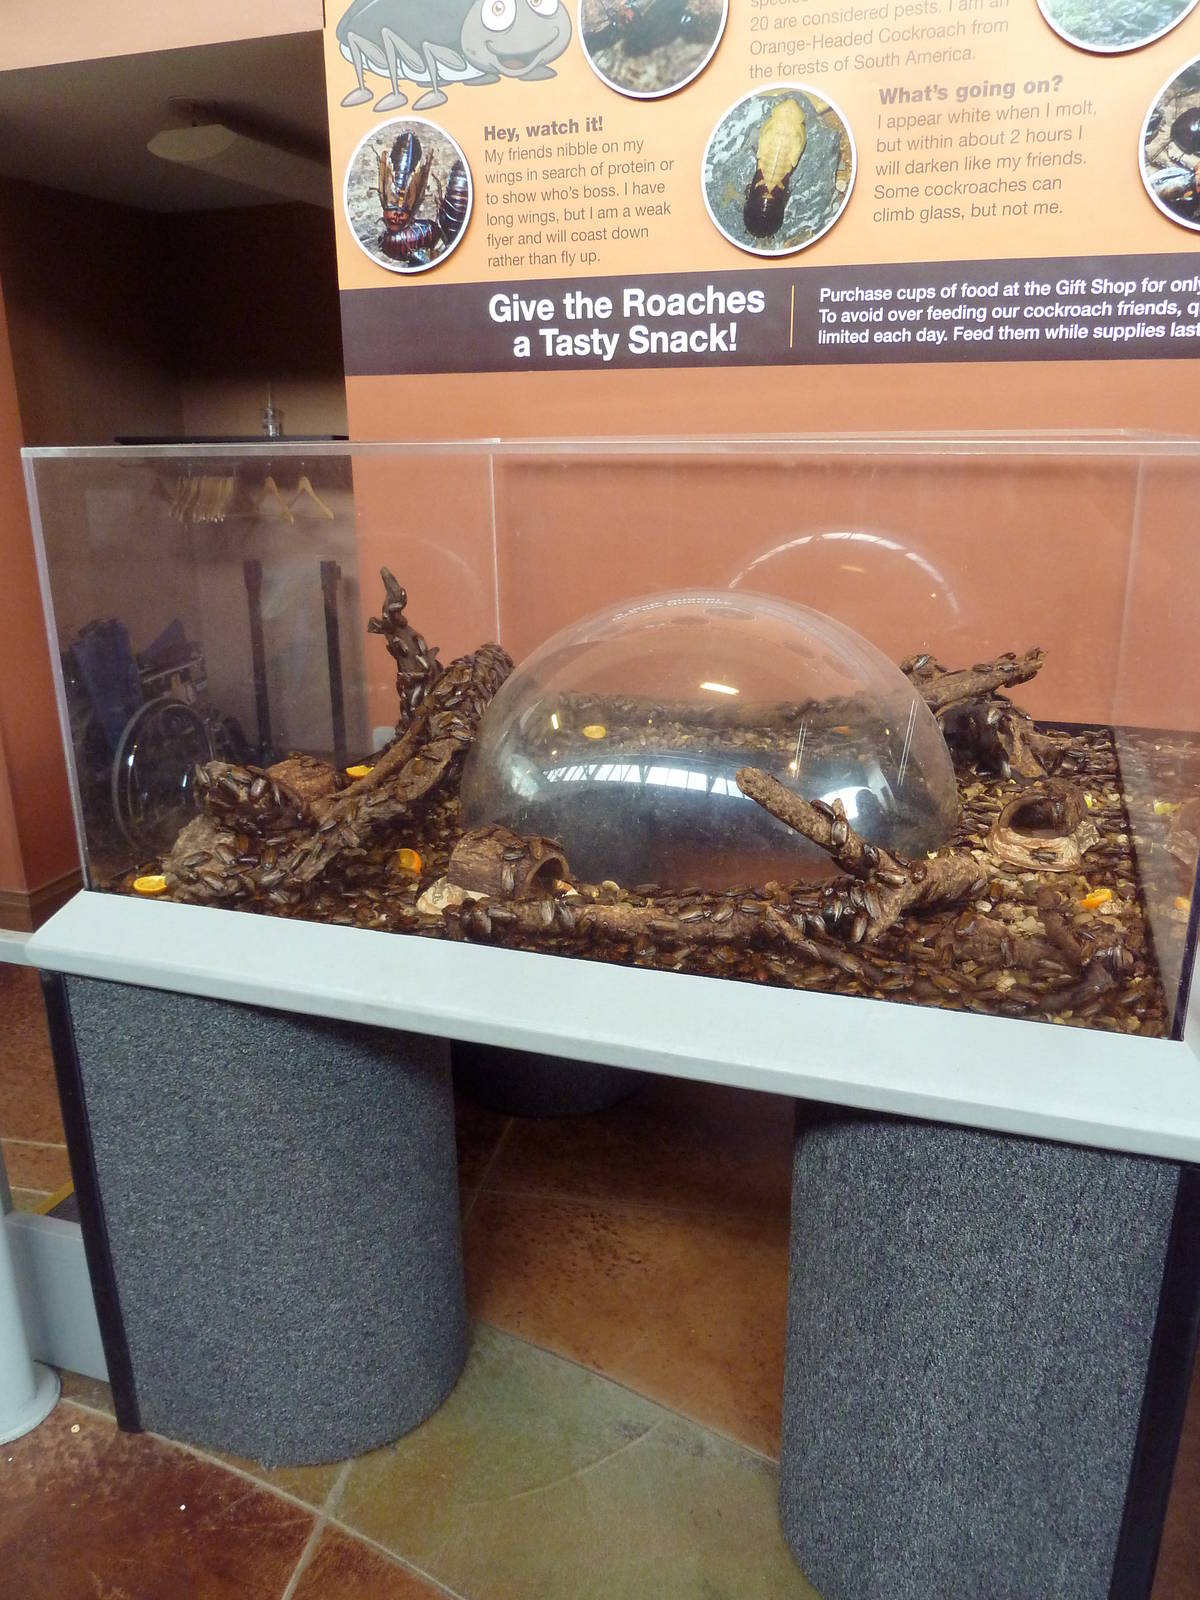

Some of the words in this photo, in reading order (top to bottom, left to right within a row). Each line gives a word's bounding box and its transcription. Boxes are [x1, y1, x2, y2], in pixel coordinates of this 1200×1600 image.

[750, 16, 768, 31] 20
[774, 16, 796, 29] are
[802, 2, 888, 26] considered
[750, 30, 872, 56] Orange-Headed
[879, 20, 965, 42] Cockroach
[971, 19, 1009, 34] from
[750, 64, 772, 79] the
[778, 60, 828, 76] forests
[834, 57, 850, 72] of
[854, 52, 900, 70] South
[906, 48, 975, 65] America.
[956, 81, 1016, 102] going
[1024, 75, 1063, 94] on?
[484, 125, 520, 142] Hey,
[526, 118, 579, 137] watch
[586, 116, 603, 132] it!
[877, 115, 881, 128] I
[887, 112, 942, 131] appear
[948, 108, 990, 124] white
[997, 105, 1040, 121] when
[1045, 103, 1049, 117] I
[877, 138, 901, 152] but
[908, 135, 953, 151] within
[959, 132, 1005, 147] about
[1010, 129, 1020, 144] 2
[1026, 127, 1072, 142] hours
[1078, 125, 1082, 140] I
[485, 149, 504, 165] My
[508, 145, 552, 161] friends
[557, 141, 597, 157] nibble
[602, 141, 618, 153] on
[624, 139, 644, 153] my
[876, 162, 899, 176] will
[905, 160, 958, 175] darken
[964, 156, 990, 171] like
[997, 157, 1020, 172] my
[1027, 151, 1086, 167] friends.
[485, 169, 522, 185] wings
[527, 169, 537, 180] in
[542, 165, 585, 179] search
[591, 163, 604, 176] of
[608, 159, 655, 178] protein
[660, 159, 674, 171] or
[486, 193, 498, 205] to
[503, 190, 536, 204] show
[584, 184, 619, 198] boss.
[623, 182, 627, 195] I
[632, 181, 665, 195] have
[874, 184, 919, 200] Some
[925, 178, 1027, 196] cockroaches
[1032, 178, 1062, 191] can
[487, 213, 513, 228] long
[518, 211, 559, 226] wings,
[564, 208, 585, 221] but
[589, 207, 593, 219] I
[598, 207, 618, 219] am
[622, 207, 631, 217] a
[636, 202, 671, 216] weak
[873, 207, 914, 223] climb
[920, 206, 964, 223] glass,
[971, 203, 996, 218] but
[1002, 202, 1028, 216] not
[1034, 202, 1063, 215] me.
[487, 233, 513, 249] flyer
[518, 232, 541, 245] and
[546, 230, 567, 243] will
[571, 228, 607, 242] coast
[612, 227, 649, 240] down
[488, 254, 525, 267] rather
[529, 252, 556, 264] than
[561, 251, 576, 266] fly
[580, 251, 600, 265] up.
[820, 288, 892, 302] Purchase
[896, 288, 936, 302] cups
[940, 284, 957, 299] of
[961, 282, 998, 298] food
[1003, 283, 1019, 297] at
[1024, 281, 1050, 296] the
[1056, 279, 1086, 295] Gift
[1091, 279, 1136, 296] Shop
[1141, 277, 1166, 292] for
[489, 294, 555, 322] Give
[563, 291, 613, 319] the
[623, 285, 765, 317] Roaches
[819, 308, 837, 323] To
[841, 307, 882, 323] avoid
[888, 308, 922, 322] over
[927, 306, 987, 322] feeding
[991, 306, 1019, 319] our
[1023, 302, 1112, 318] cockroach
[1117, 301, 1182, 318] friends,
[513, 336, 531, 357] a
[539, 328, 619, 362] Tasty
[628, 323, 737, 355] Snack!
[818, 329, 869, 344] limited
[873, 328, 911, 343] each
[916, 328, 948, 344] day.
[953, 327, 992, 341] Feed
[999, 326, 1040, 340] them
[1045, 324, 1088, 339] while
[1092, 324, 1164, 339] supplies
